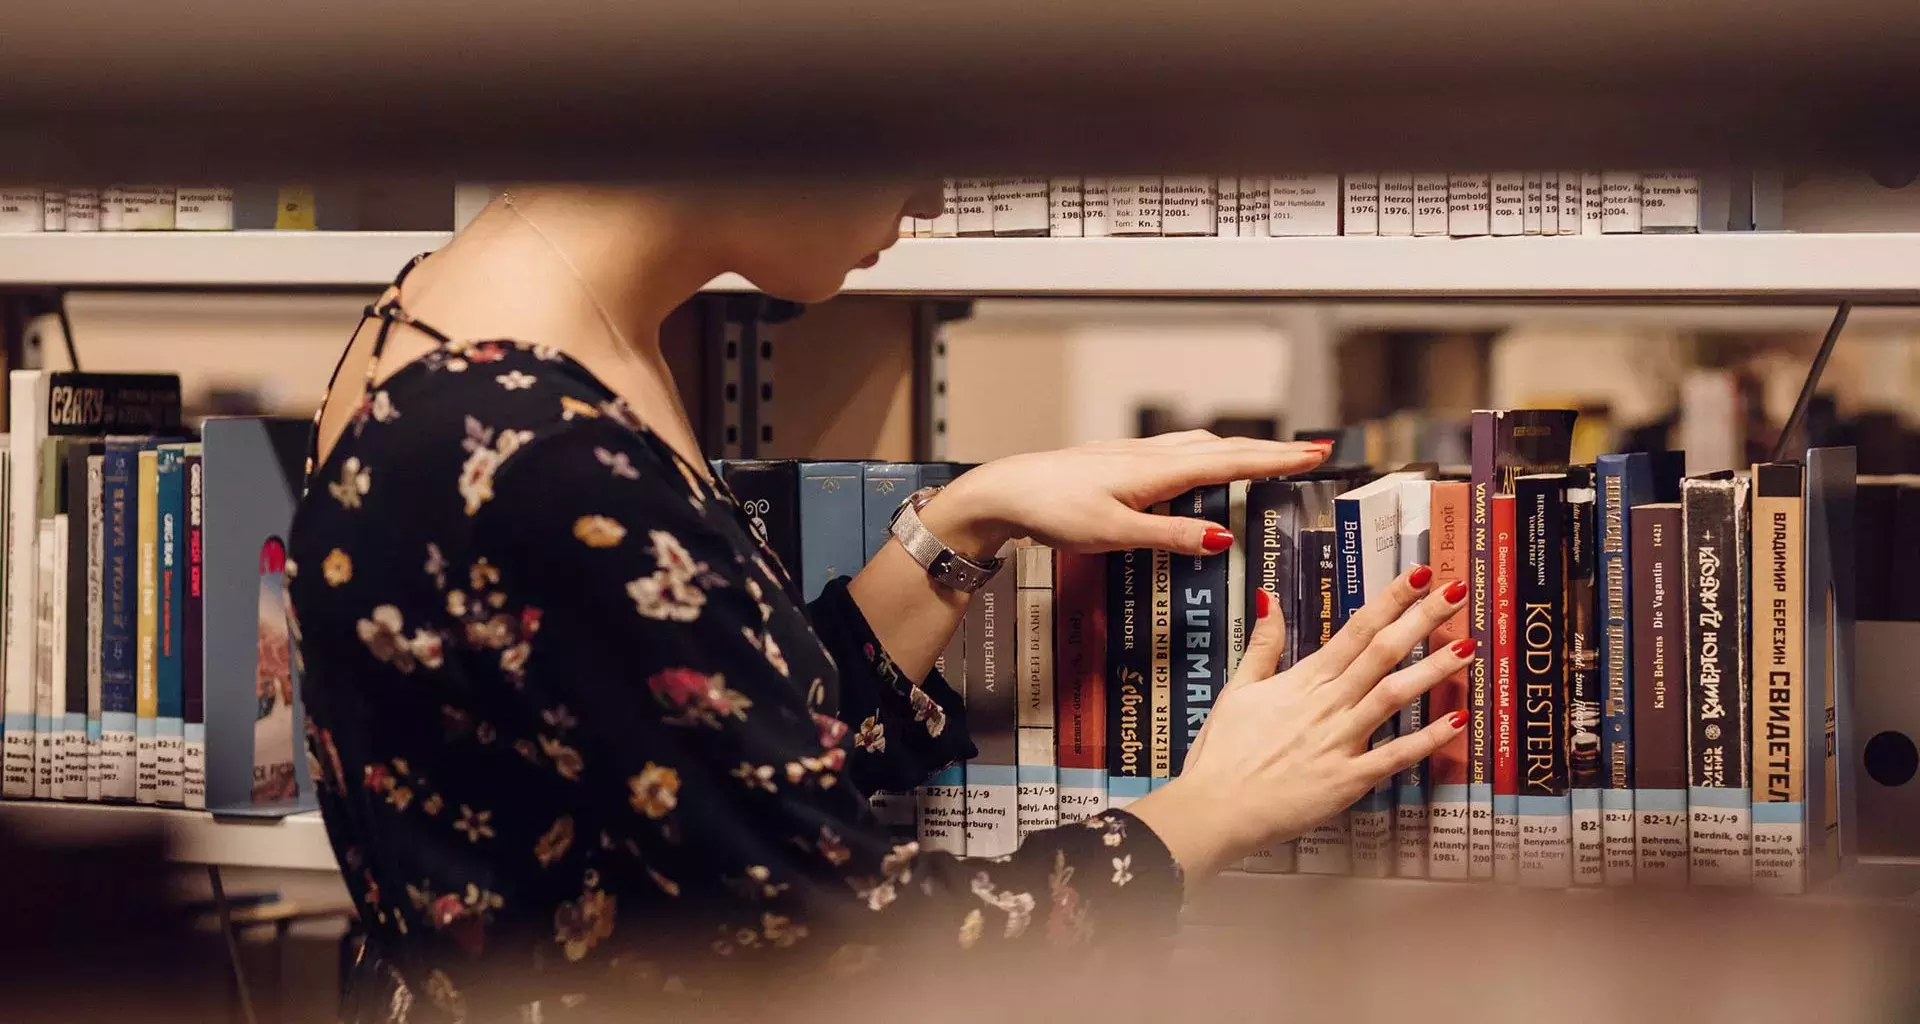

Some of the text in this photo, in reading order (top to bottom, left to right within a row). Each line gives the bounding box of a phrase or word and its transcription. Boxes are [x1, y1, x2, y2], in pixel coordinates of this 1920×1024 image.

[959, 206, 985, 214] 1948.
[1384, 207, 1411, 215] 1976.
[1603, 208, 1629, 216] 2004.
[1263, 509, 1281, 548] david
[1440, 504, 1455, 552] Benoit
[1536, 493, 1546, 587] BERNARD BENYAMIN
[1343, 520, 1361, 595] Benjamin
[1474, 482, 1486, 631] ANTYCHRYST PAN ŚWIATA
[1773, 512, 1787, 592] ВЛАДИМИР
[1124, 569, 1136, 596] ANN
[1653, 562, 1666, 609] Vagantin
[1156, 599, 1168, 628] DER
[1320, 590, 1332, 619] Band
[1653, 609, 1664, 629] Die
[1124, 599, 1136, 650] BENDER
[1773, 599, 1787, 665] БЕРЕЗИН
[1156, 632, 1168, 661] BIN
[1653, 635, 1664, 679] Behrens
[1156, 666, 1168, 689] ICH
[1474, 657, 1485, 707] BENSON
[1498, 657, 1510, 708] WZIĘŁAM
[1573, 632, 1588, 738] Zawód: żona filozofa
[1525, 602, 1553, 794] KOD ESTERY
[1653, 678, 1666, 709] Katja
[1156, 705, 1168, 770] BELZNER
[1474, 708, 1485, 756] HUGON
[977, 807, 1006, 815] Andrej
[1061, 795, 1099, 806] 82-1/-9
[1061, 813, 1083, 822] Belyj,
[1433, 827, 1466, 835] Benoit,
[1523, 826, 1558, 835] 82-1/-9
[1694, 812, 1738, 824] 82-1/-9
[1472, 842, 1490, 851] Pan
[1693, 831, 1733, 841] Berdnik,
[1754, 835, 1793, 843] 82-1/-9
[1433, 854, 1459, 862] 1981.
[1641, 849, 1657, 857] Die
[1692, 846, 1740, 856] Kamerton
